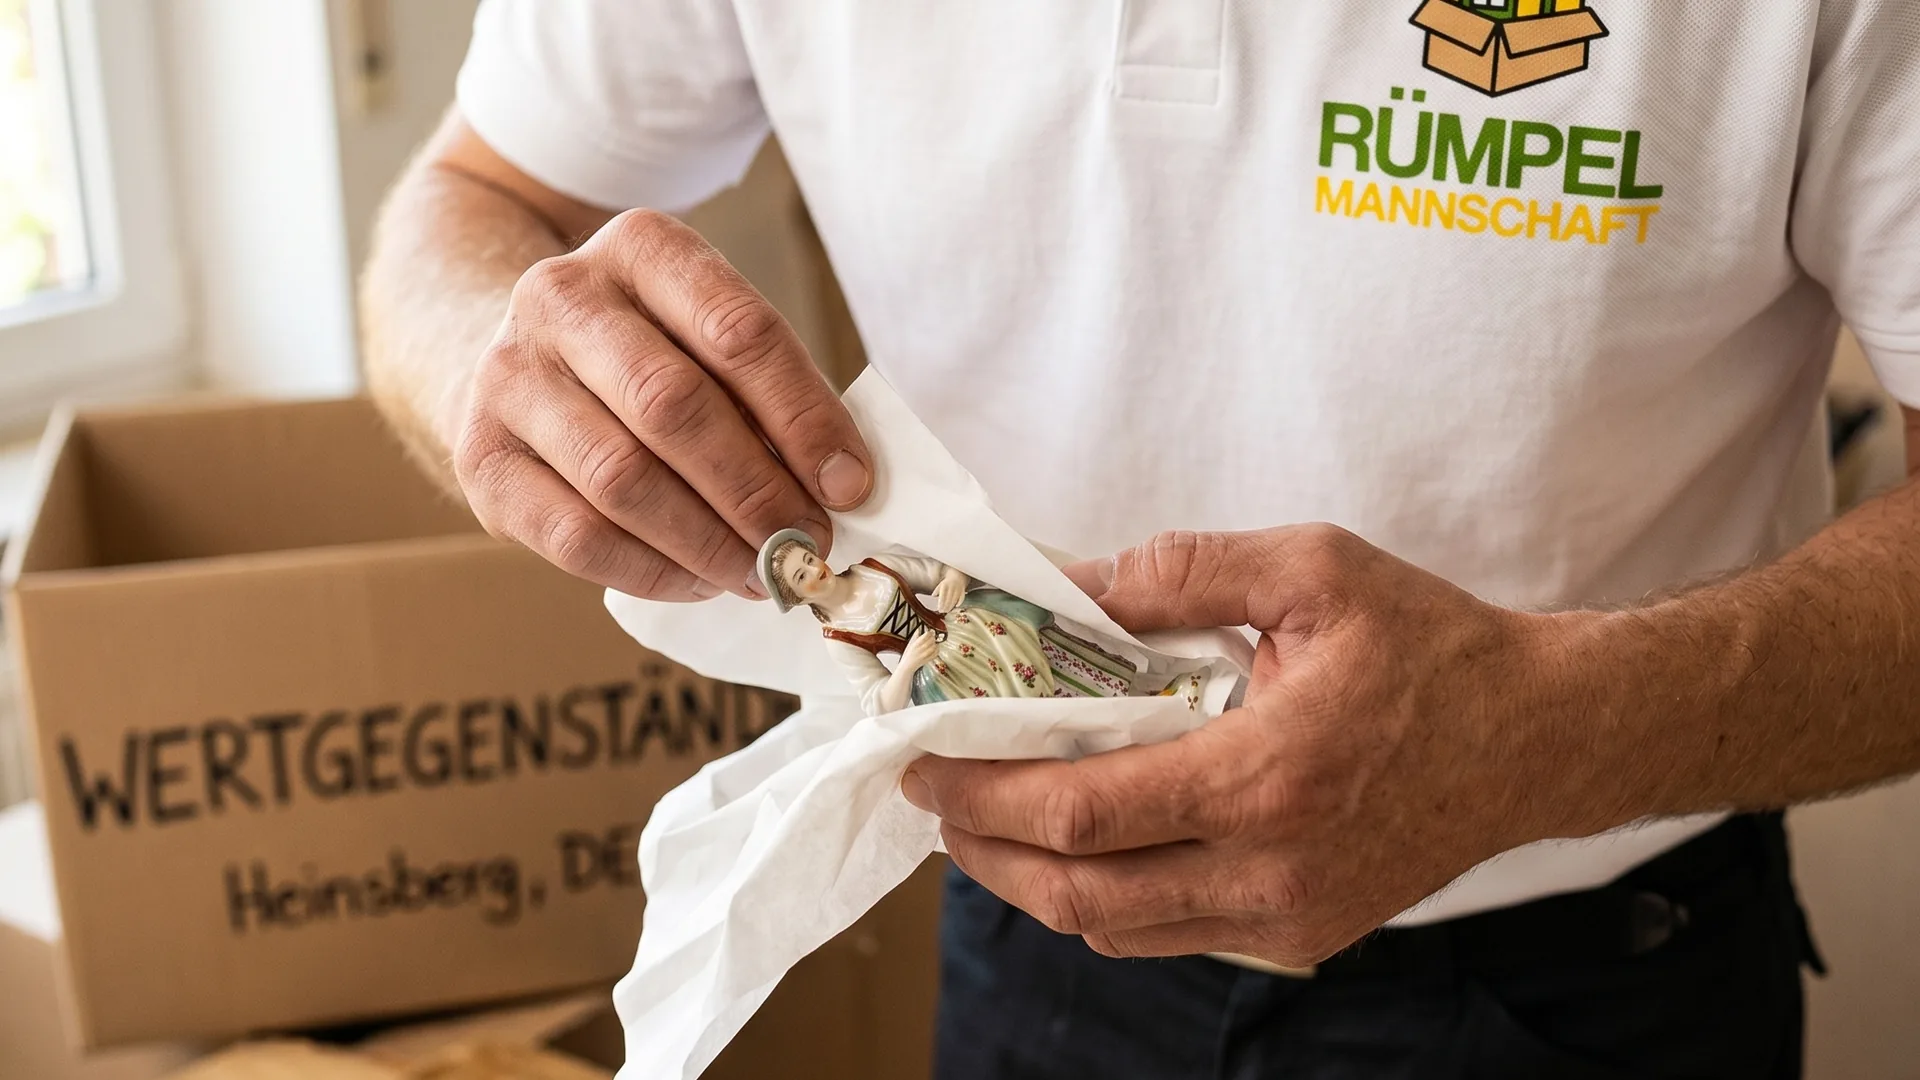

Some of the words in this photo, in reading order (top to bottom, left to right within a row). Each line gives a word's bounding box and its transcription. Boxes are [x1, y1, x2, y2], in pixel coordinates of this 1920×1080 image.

[1318, 86, 1664, 199] RÜMPEL
[1315, 176, 1660, 245] MANNSCHAFT
[59, 660, 801, 833] WERTGEGENSTÄND
[224, 852, 546, 934] Heinsberg,
